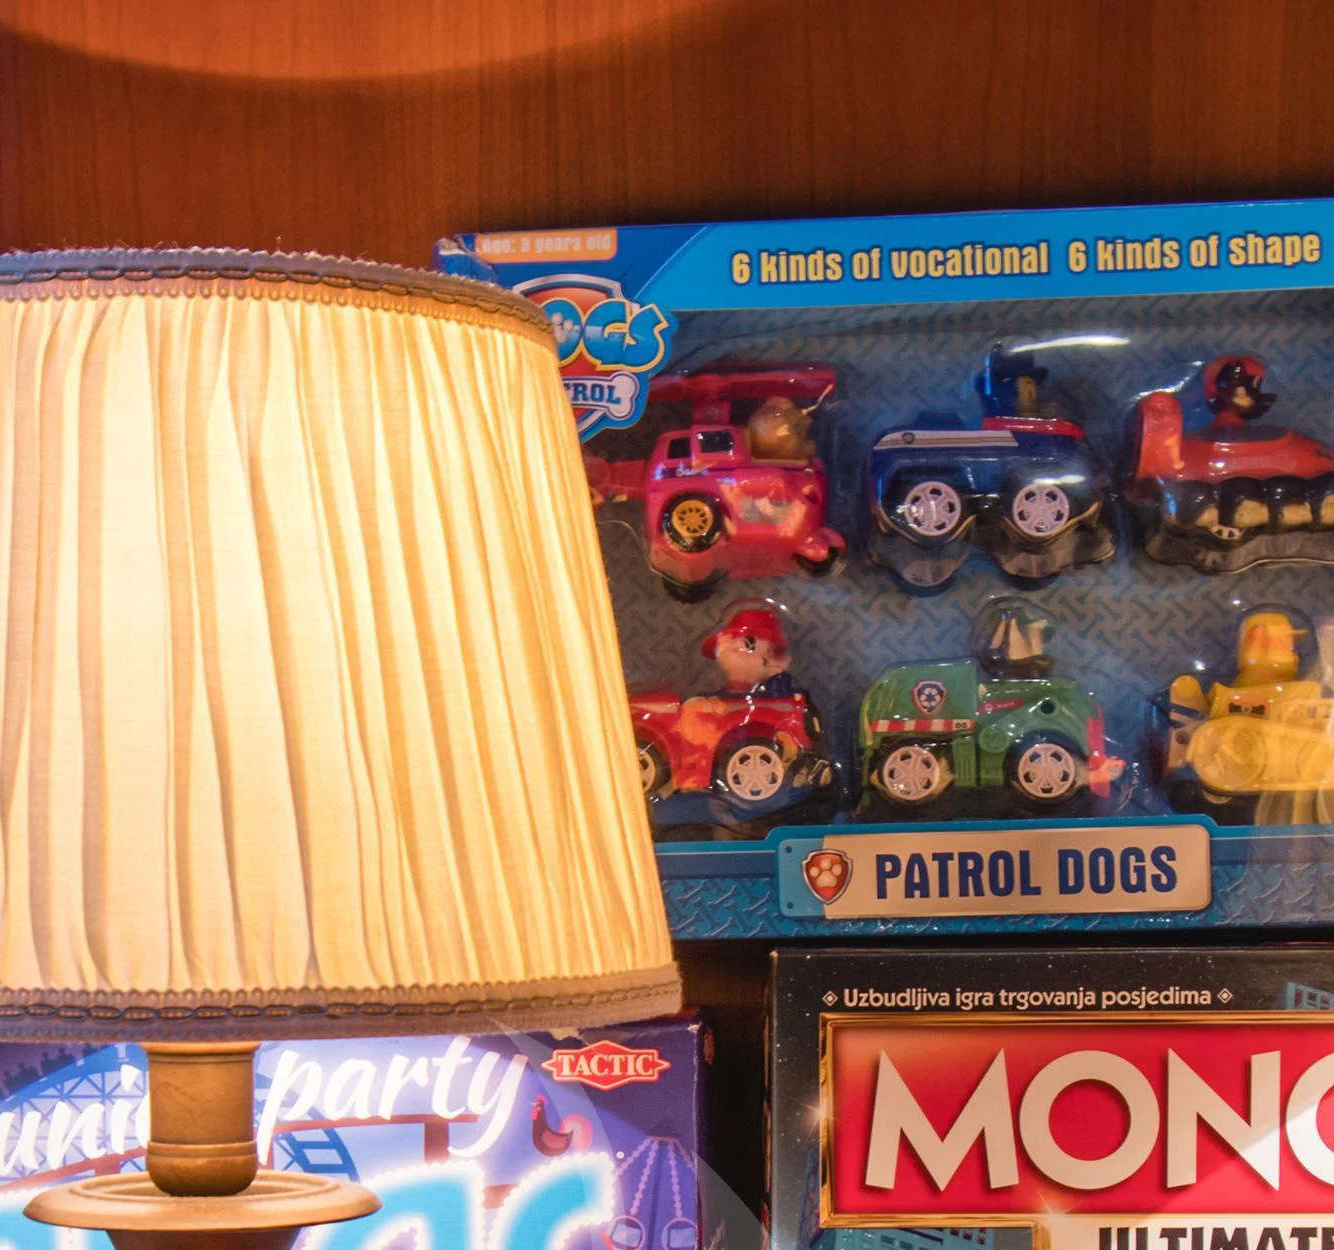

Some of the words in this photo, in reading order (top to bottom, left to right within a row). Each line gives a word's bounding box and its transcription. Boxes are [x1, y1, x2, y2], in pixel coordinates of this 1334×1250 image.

[521, 237, 530, 253] 3
[535, 236, 582, 256] years
[586, 234, 612, 251] old
[730, 252, 750, 284] 6
[760, 249, 841, 284] kinds
[852, 246, 882, 281] of
[890, 241, 1049, 280] vocational
[1068, 242, 1087, 273] 6
[1096, 237, 1179, 272] kinds
[1190, 234, 1219, 268] of
[1228, 232, 1321, 269] shape
[875, 849, 1042, 900] PATROL
[1058, 845, 1178, 896] DOGS
[843, 988, 951, 1011] Uzbudljiva
[955, 989, 994, 1010] igra
[999, 988, 1096, 1010] trgovanja
[1101, 986, 1212, 1010] posjedima
[557, 1052, 655, 1078] TACTIC
[257, 1035, 528, 1163] party
